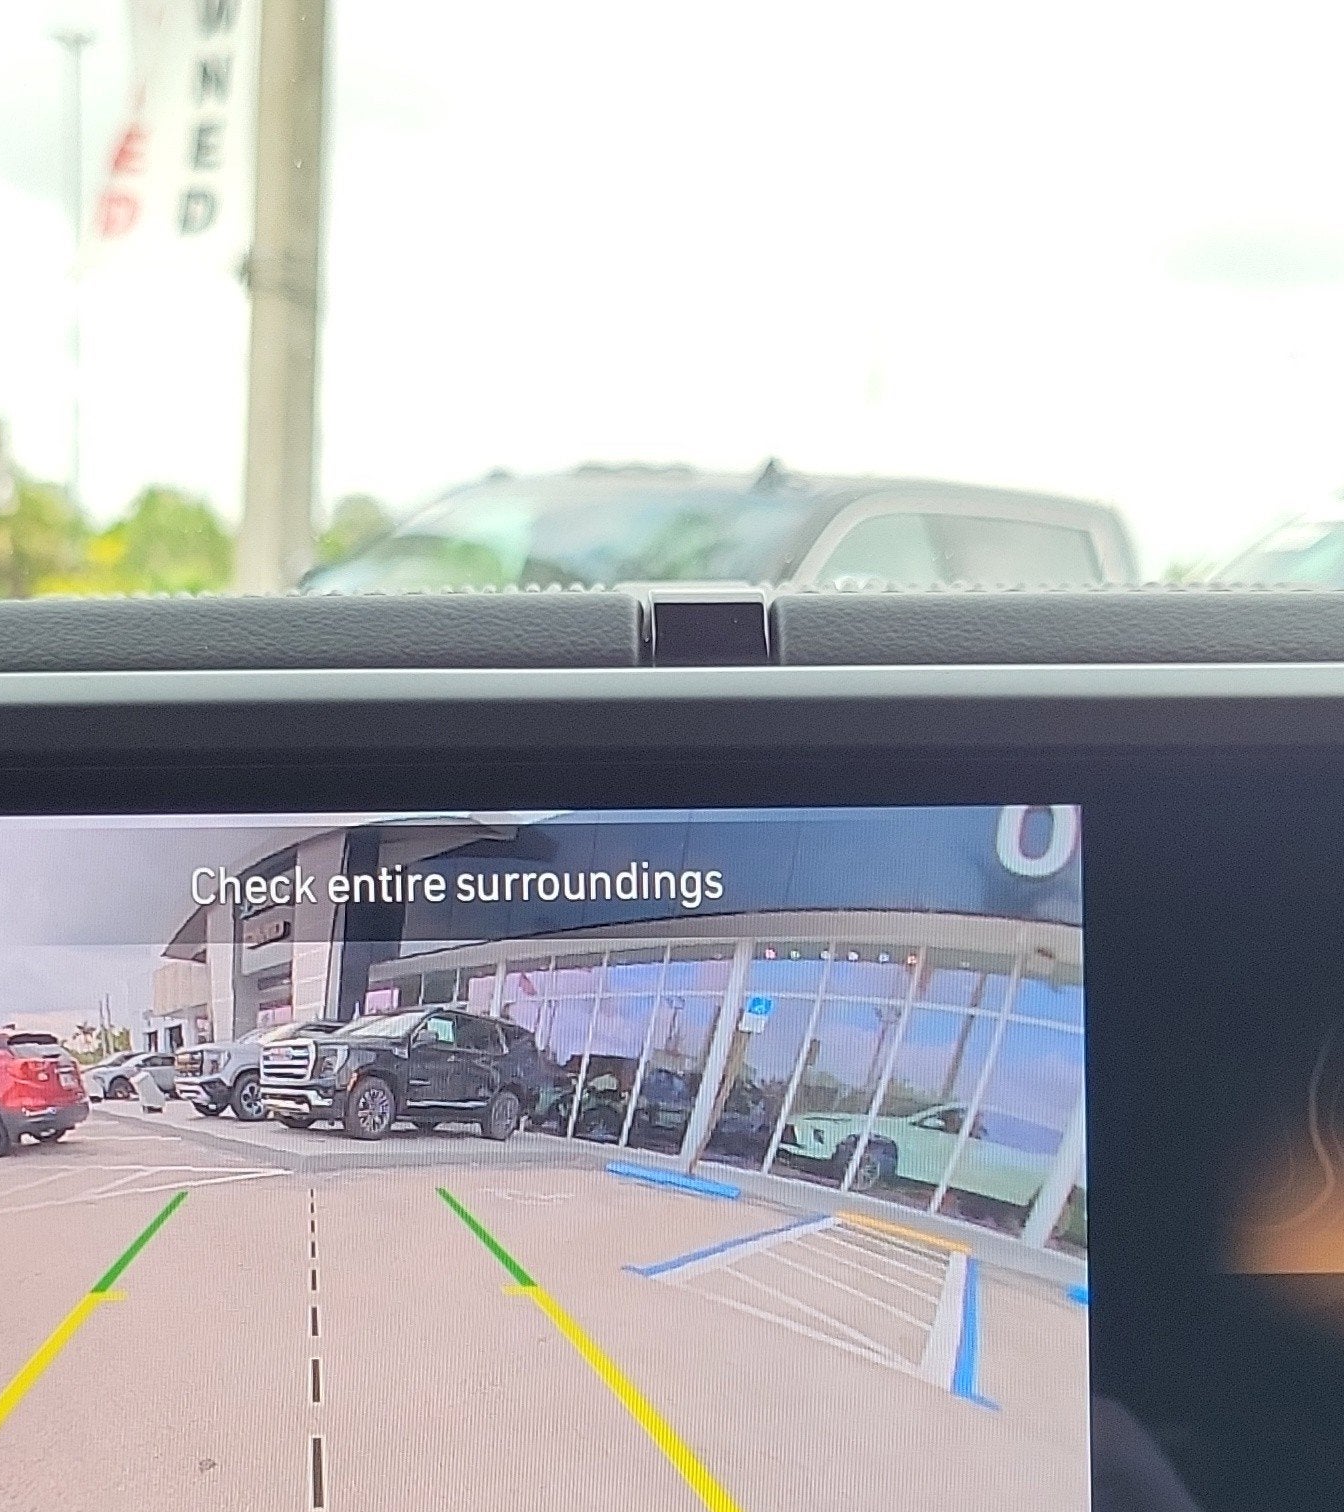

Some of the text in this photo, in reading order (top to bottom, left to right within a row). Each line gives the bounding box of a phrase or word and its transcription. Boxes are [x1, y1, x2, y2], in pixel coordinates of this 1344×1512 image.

[191, 861, 724, 909] Check entire surroundings
